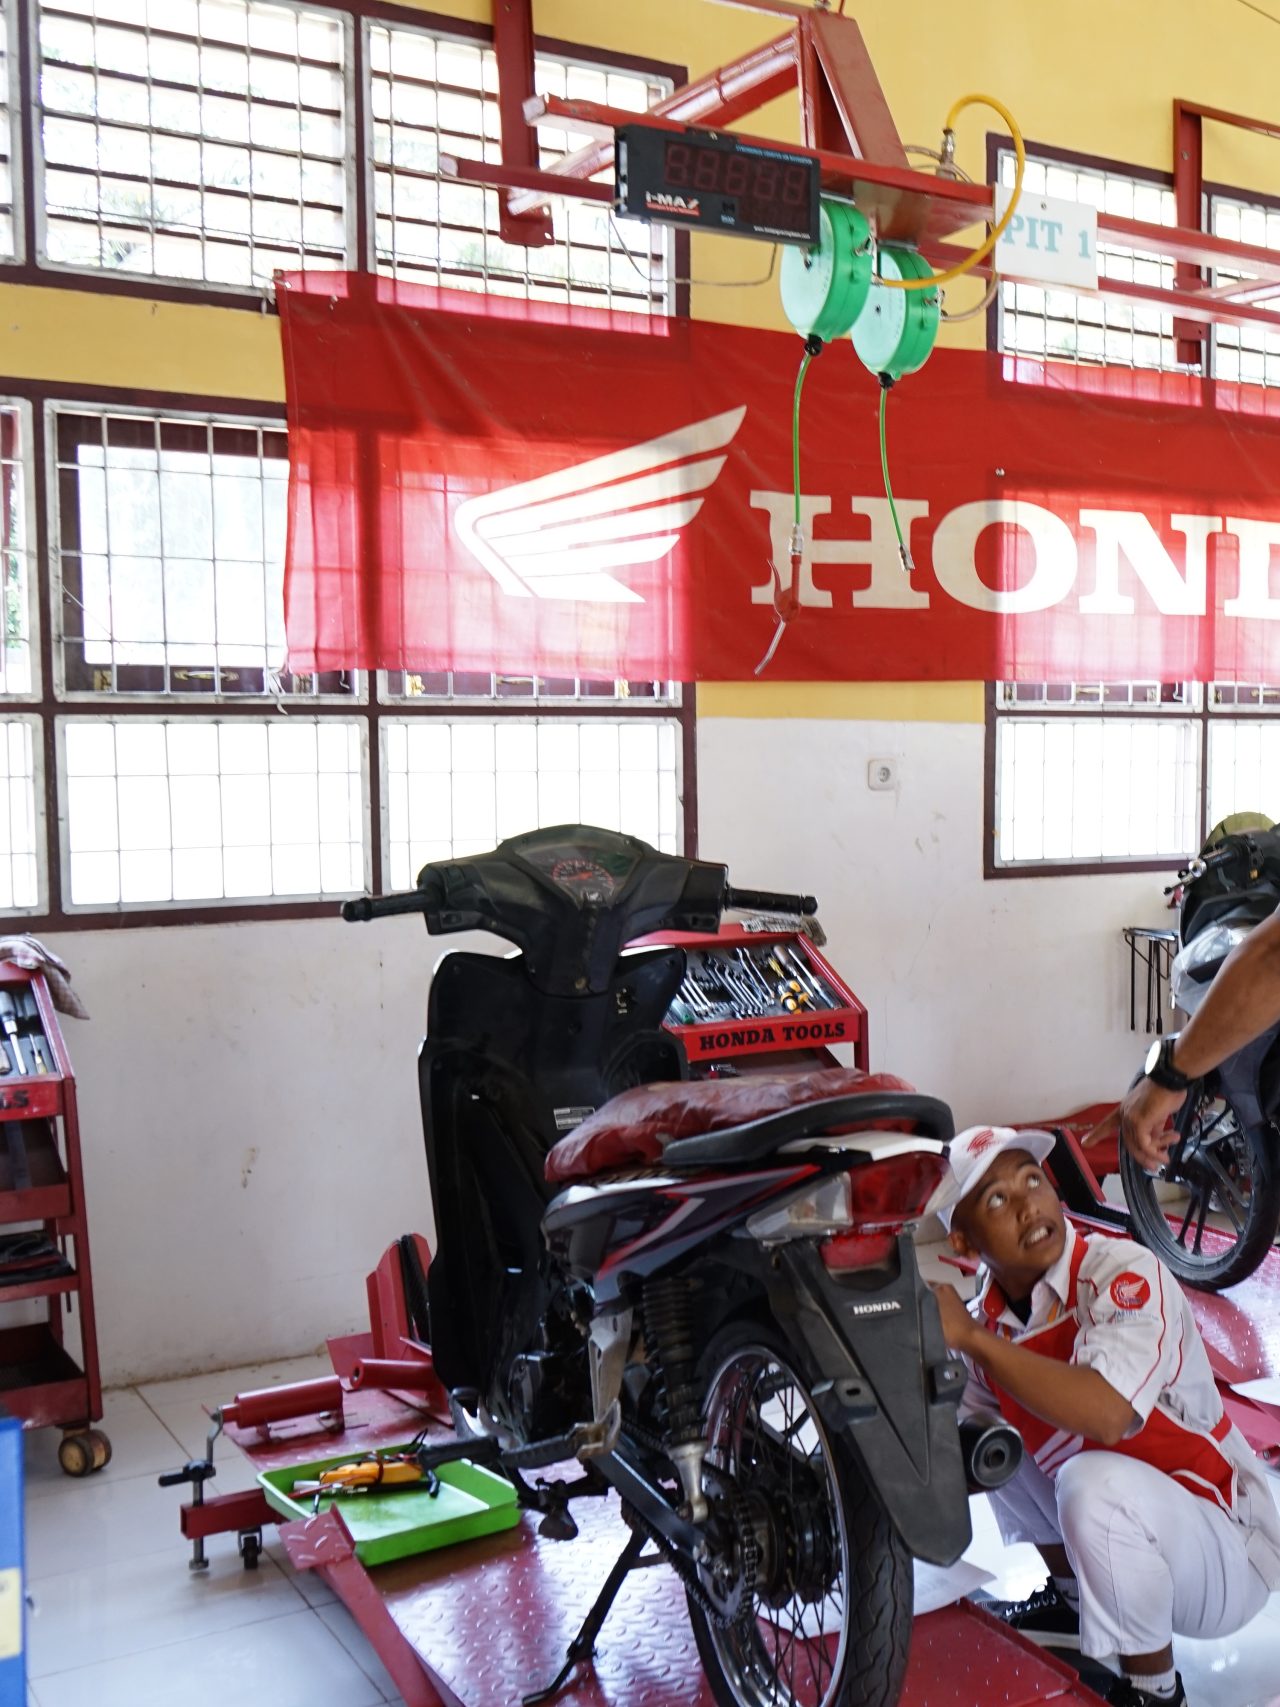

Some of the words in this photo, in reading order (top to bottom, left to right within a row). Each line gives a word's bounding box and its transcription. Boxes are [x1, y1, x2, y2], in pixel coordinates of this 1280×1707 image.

[1002, 213, 1063, 253] PIT
[1078, 230, 1092, 259] 1
[700, 1028, 775, 1051] HONDA
[782, 1022, 845, 1041] TOOLS
[853, 1300, 901, 1316] HONDA
